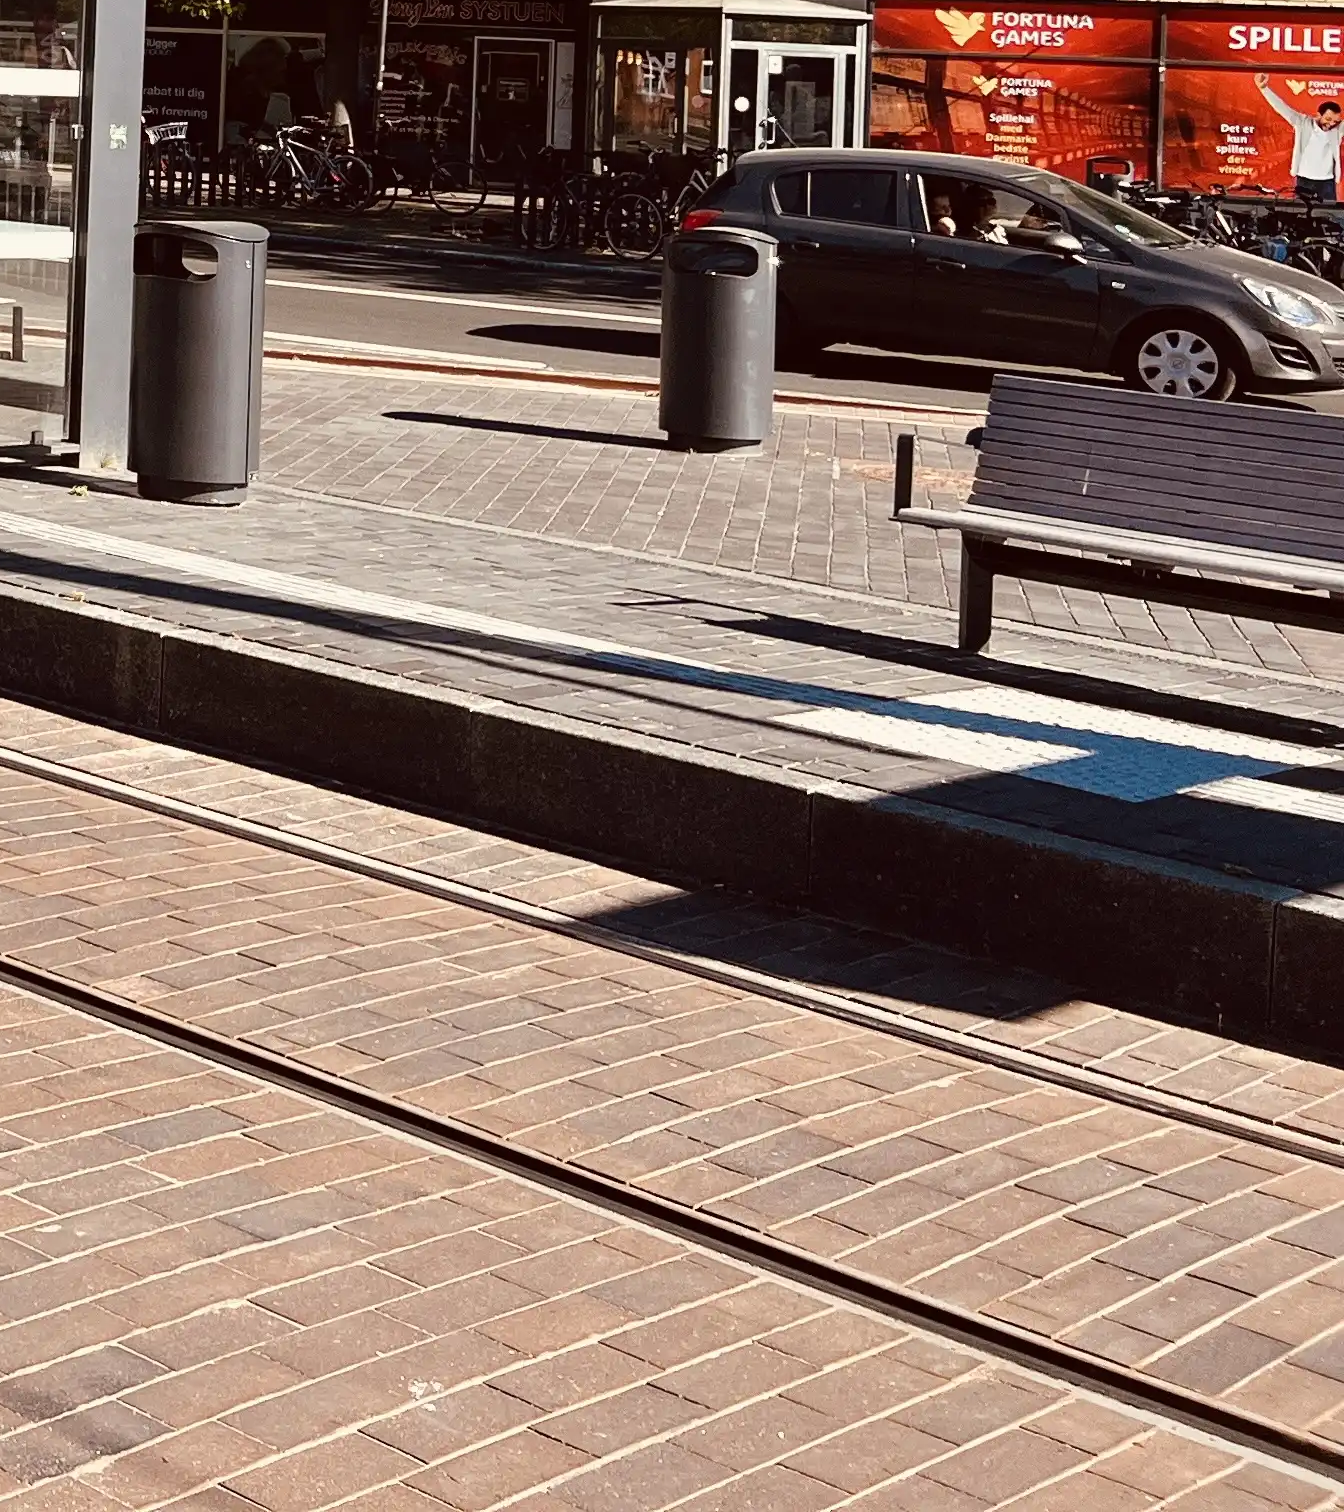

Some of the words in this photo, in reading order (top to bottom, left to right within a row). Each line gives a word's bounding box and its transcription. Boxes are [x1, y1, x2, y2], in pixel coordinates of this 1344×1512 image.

[459, 0, 566, 25] SYSTUEN
[991, 11, 1095, 30] FORTUNA
[990, 29, 1065, 48] GAMES
[1000, 77, 1053, 88] FORTUNA
[1308, 80, 1344, 90] FORTUN
[1000, 87, 1039, 97] GAMES
[989, 113, 1035, 125] Spillehal
[1220, 123, 1240, 133] Det
[1242, 126, 1255, 134] er
[1226, 134, 1248, 144] kun
